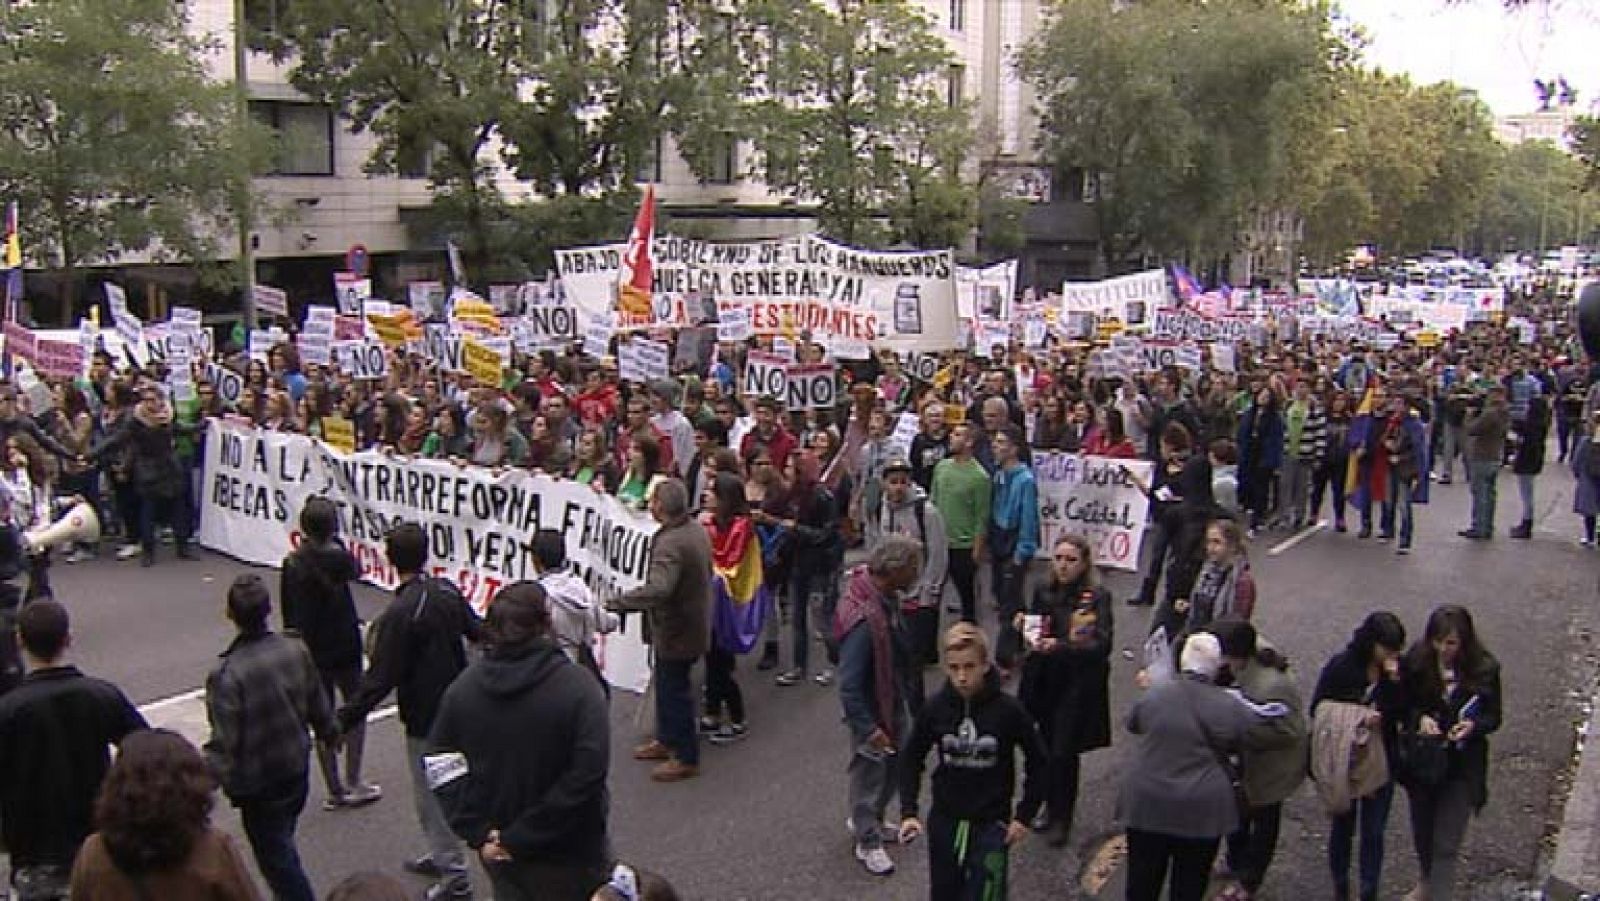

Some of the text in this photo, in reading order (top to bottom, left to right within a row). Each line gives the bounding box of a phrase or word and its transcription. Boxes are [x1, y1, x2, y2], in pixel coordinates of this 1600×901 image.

[561, 250, 620, 273] ABAJO
[653, 267, 722, 296] HUELGA
[351, 344, 384, 377] NO
[747, 364, 786, 397] NO
[788, 374, 834, 408] NO
[221, 433, 242, 469] NO
[253, 438, 267, 473] A
